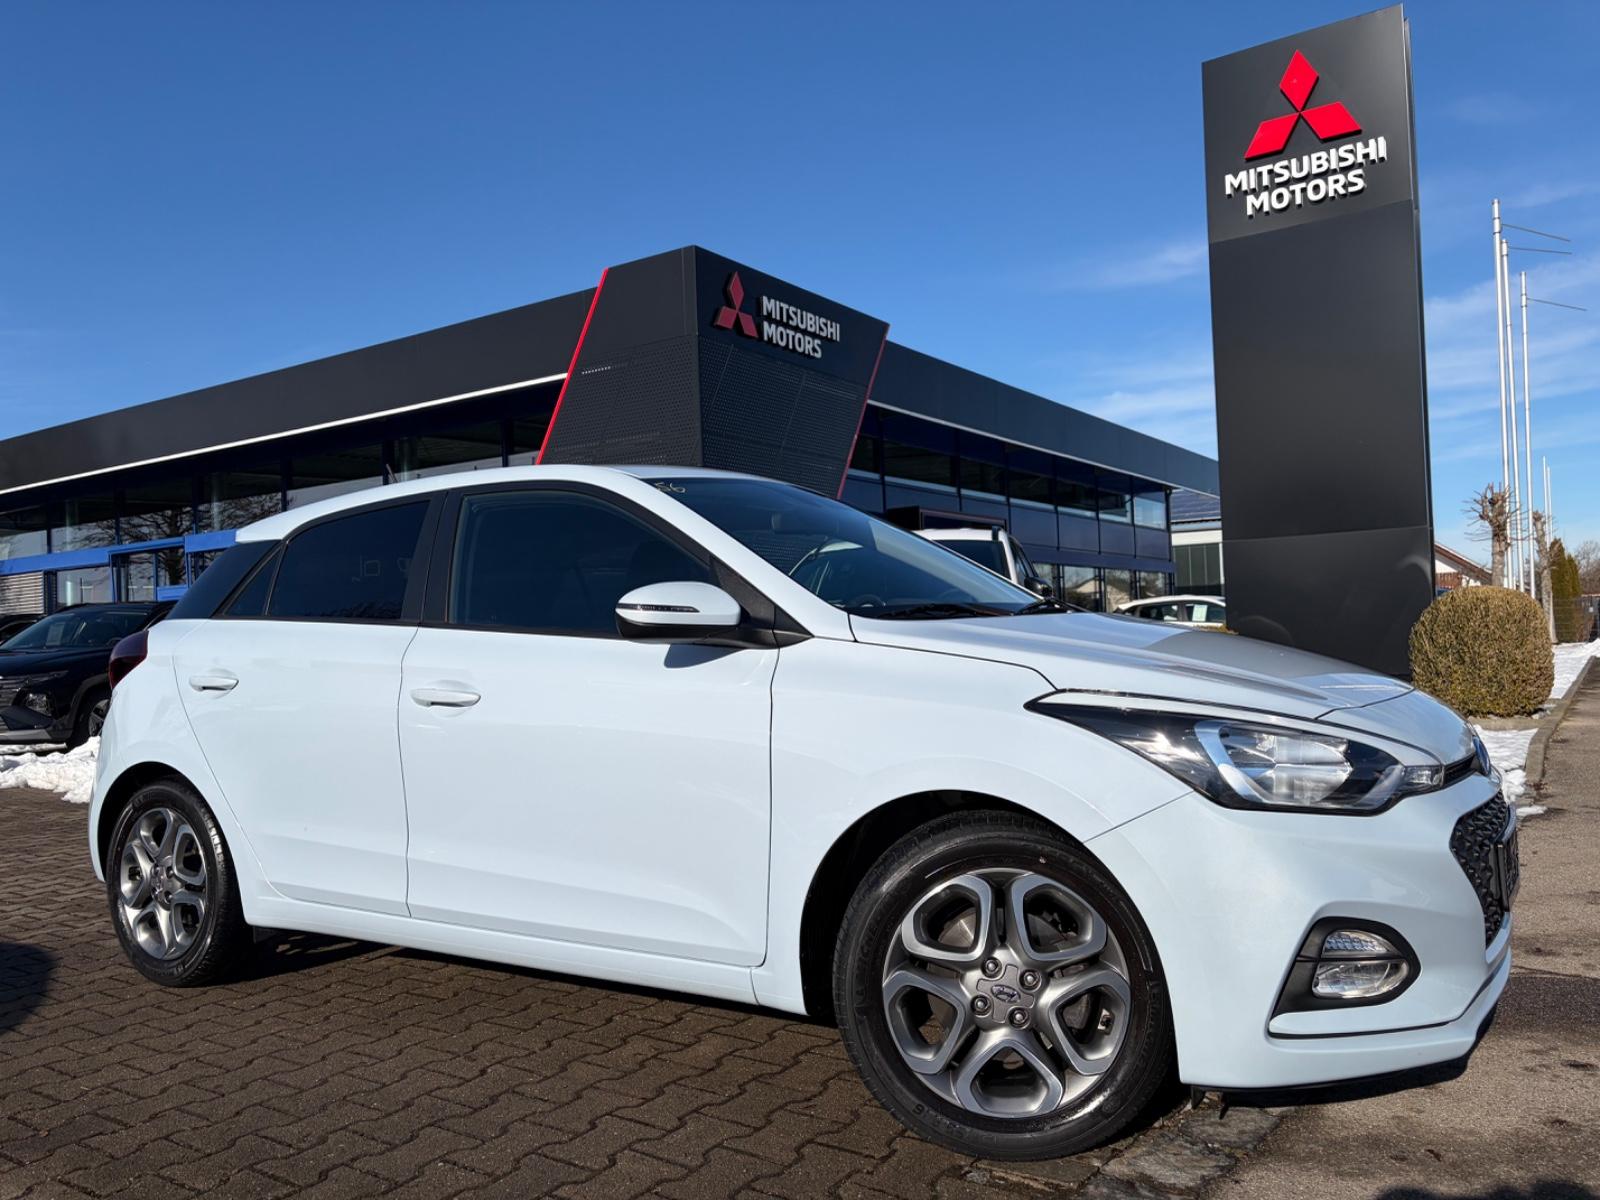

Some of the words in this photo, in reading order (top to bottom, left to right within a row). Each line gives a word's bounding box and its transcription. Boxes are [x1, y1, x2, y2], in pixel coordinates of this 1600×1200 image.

[1224, 136, 1387, 196] MITSUBISHI
[1246, 168, 1367, 217] MOTORS
[762, 295, 840, 342] MITSUBISHI
[763, 320, 822, 359] MOTORS
